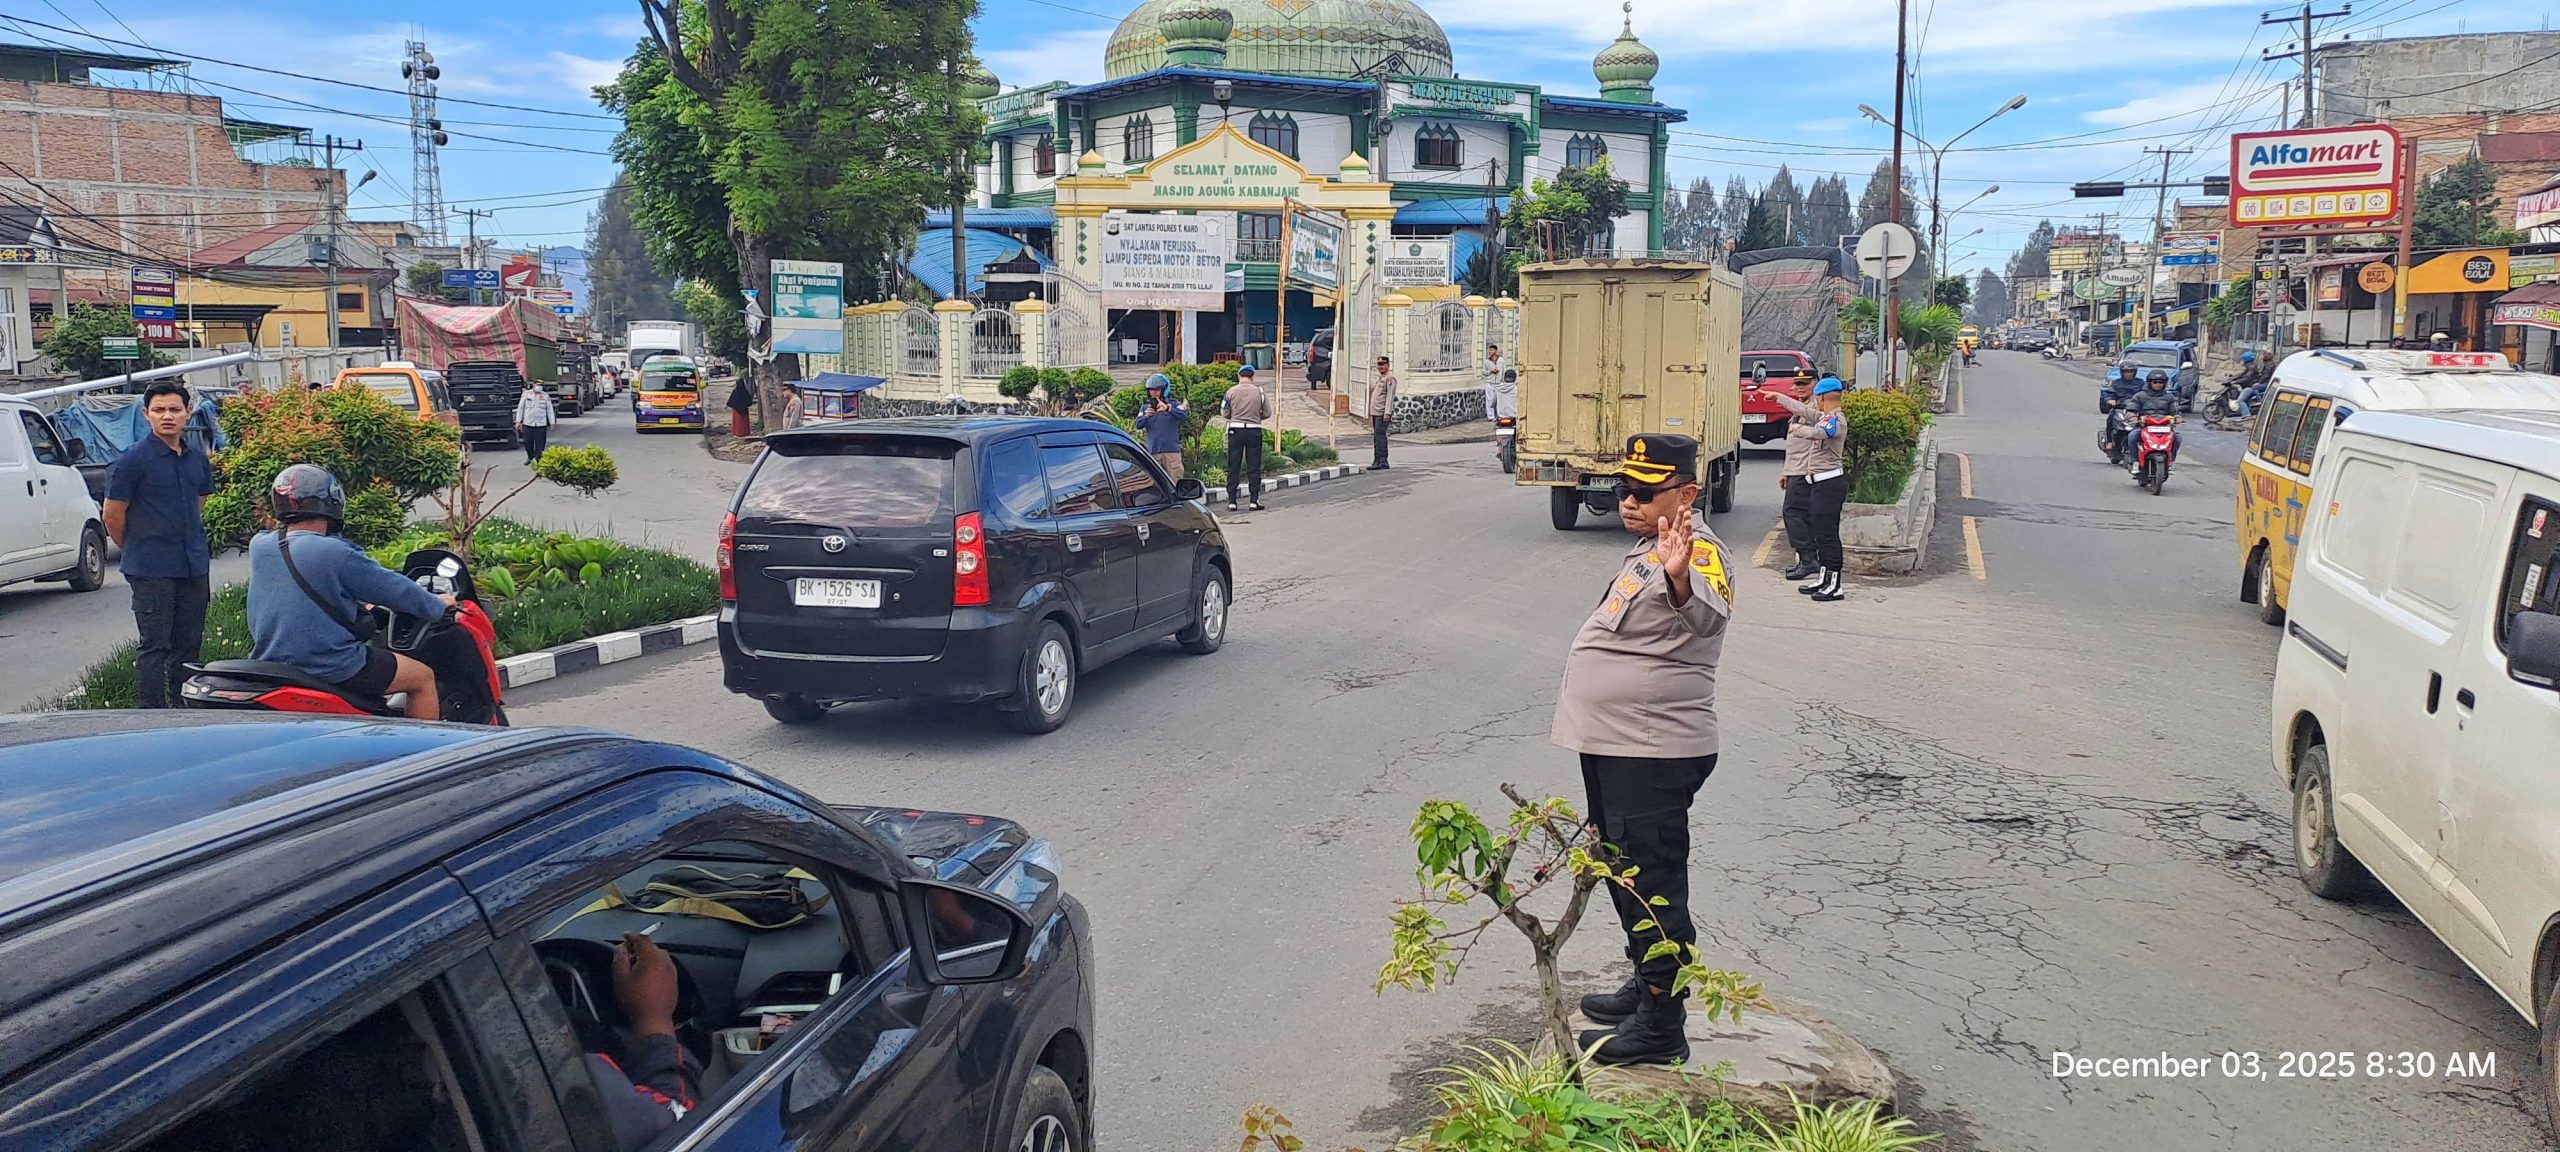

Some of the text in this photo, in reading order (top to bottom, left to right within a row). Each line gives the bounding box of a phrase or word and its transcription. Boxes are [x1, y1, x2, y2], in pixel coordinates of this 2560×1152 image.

[1412, 82, 1516, 104] MASJID AGUNG
[2250, 139, 2383, 166] Alfamart
[1173, 164, 1277, 176] SELAMAT DATANG
[1223, 176, 1233, 185] di
[1153, 185, 1300, 198] MASJID AGUNG KABANJAHE
[1123, 223, 1199, 233] SAT LANTAS POLRES T. KARO
[1119, 239, 1160, 252] NYALAKAN
[1105, 252, 1221, 267] LAMPU SEPEDA MOTOR / BETOR
[2467, 261, 2493, 271] BEST
[1123, 267, 1203, 281] SIANG & MALAM HARI
[2104, 274, 2140, 283] Amanda
[2465, 270, 2492, 279] BOWL
[778, 275, 837, 287] Aksi Penipuan
[1132, 281, 1143, 289] NO.
[1151, 282, 1171, 290] TAHUN
[787, 285, 804, 294] ATM
[1126, 297, 1146, 306] One
[147, 324, 172, 338] 100 M
[2427, 353, 2495, 367] KT
[1633, 561, 1651, 580] POLRI
[800, 579, 877, 598] BK 1526 SA
